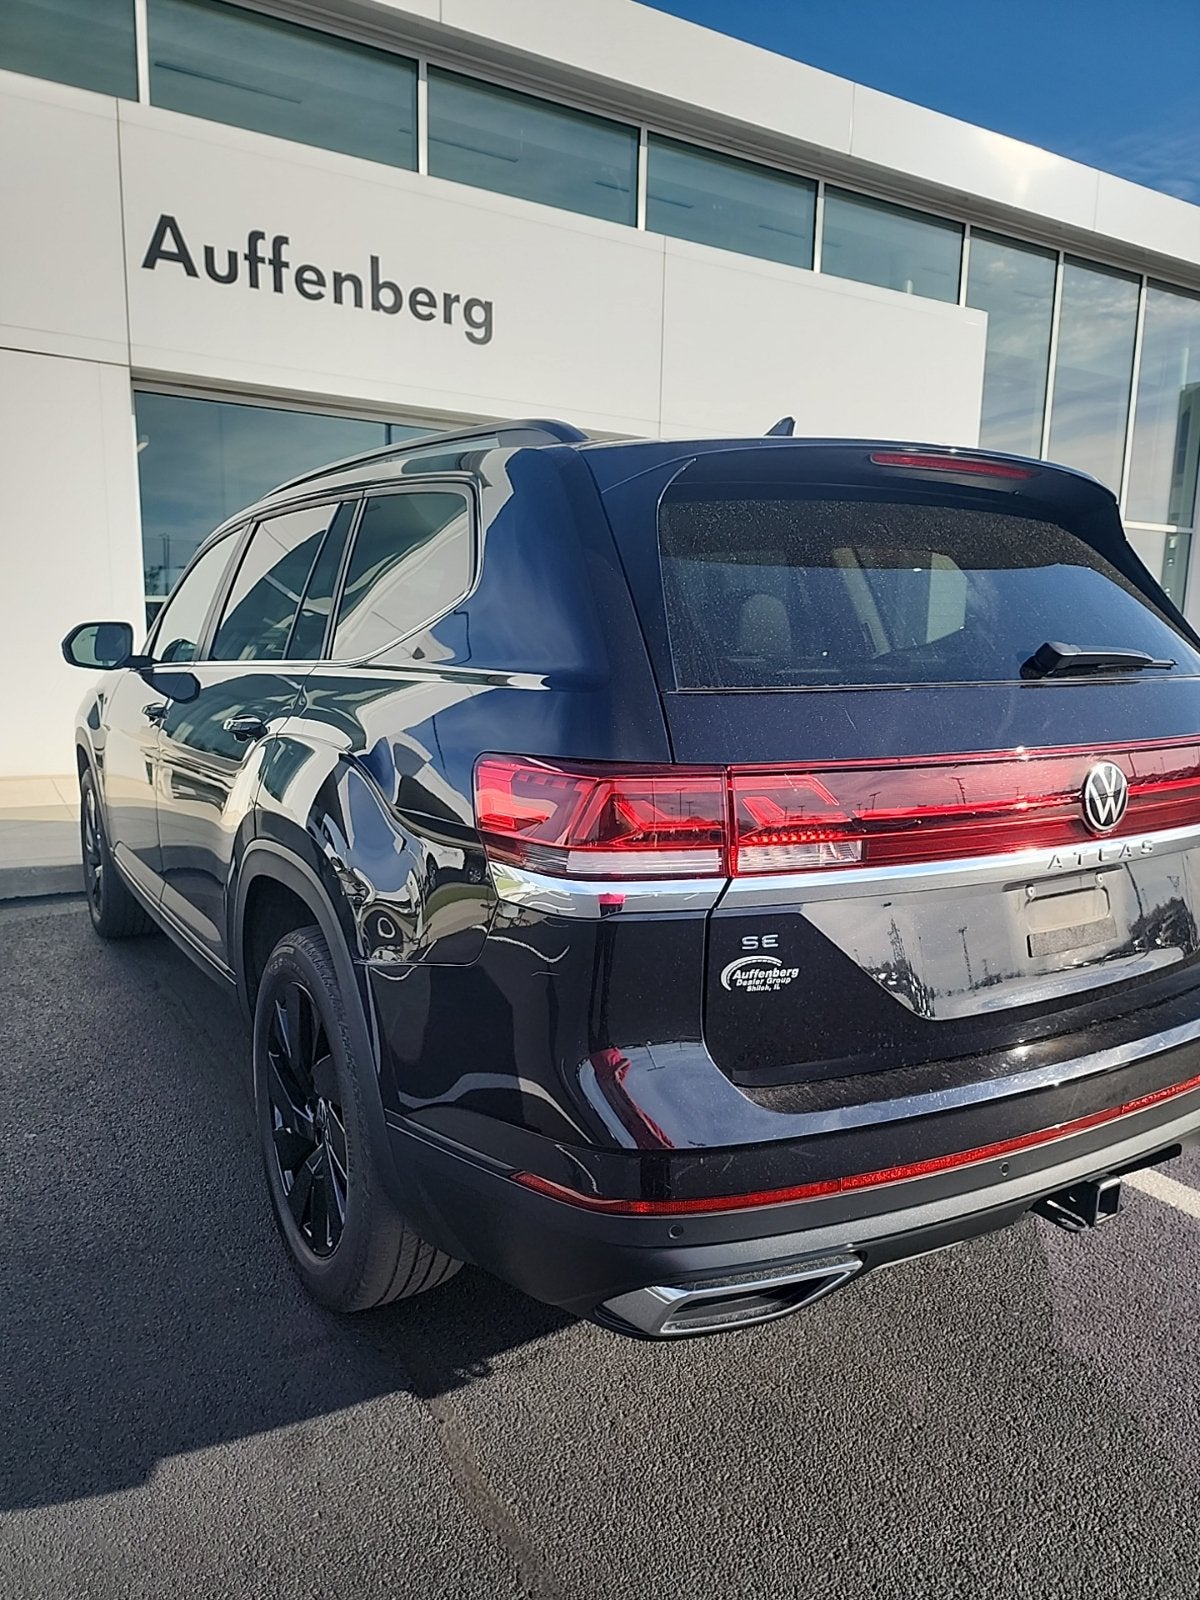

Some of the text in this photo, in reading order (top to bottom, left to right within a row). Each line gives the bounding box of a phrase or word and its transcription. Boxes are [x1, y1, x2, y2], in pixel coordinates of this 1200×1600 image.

[141, 213, 494, 345] Auffenberg
[1047, 840, 1153, 870] ATLAS
[741, 934, 779, 950] SE
[732, 967, 799, 980] Auffenberg
[736, 977, 792, 987] Dealer Group
